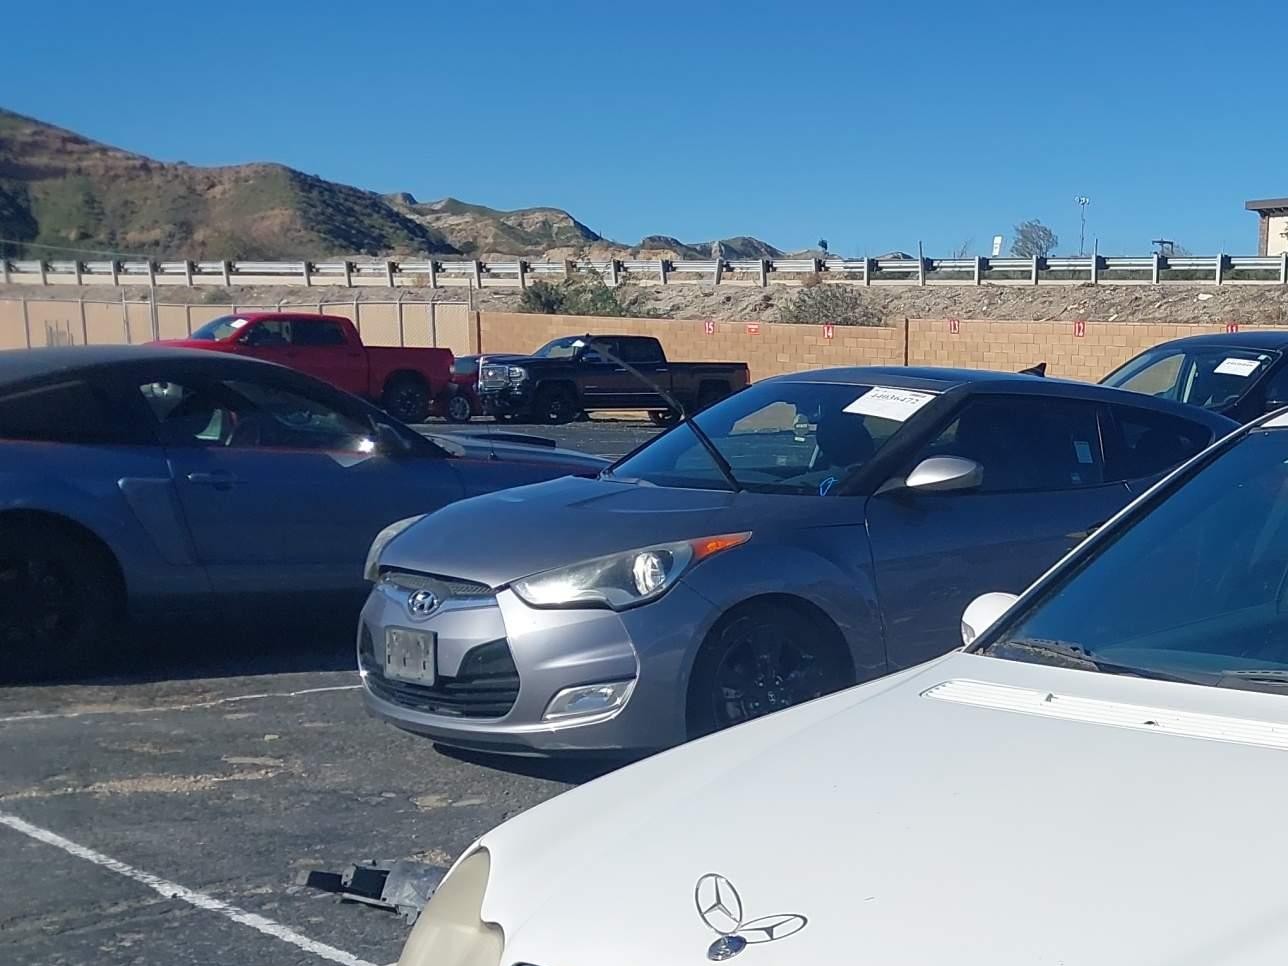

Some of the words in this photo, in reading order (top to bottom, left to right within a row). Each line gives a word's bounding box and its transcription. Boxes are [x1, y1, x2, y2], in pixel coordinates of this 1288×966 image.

[704, 322, 714, 334] 15
[823, 326, 833, 338] 14
[950, 320, 959, 333] 13
[1075, 321, 1085, 337] 12
